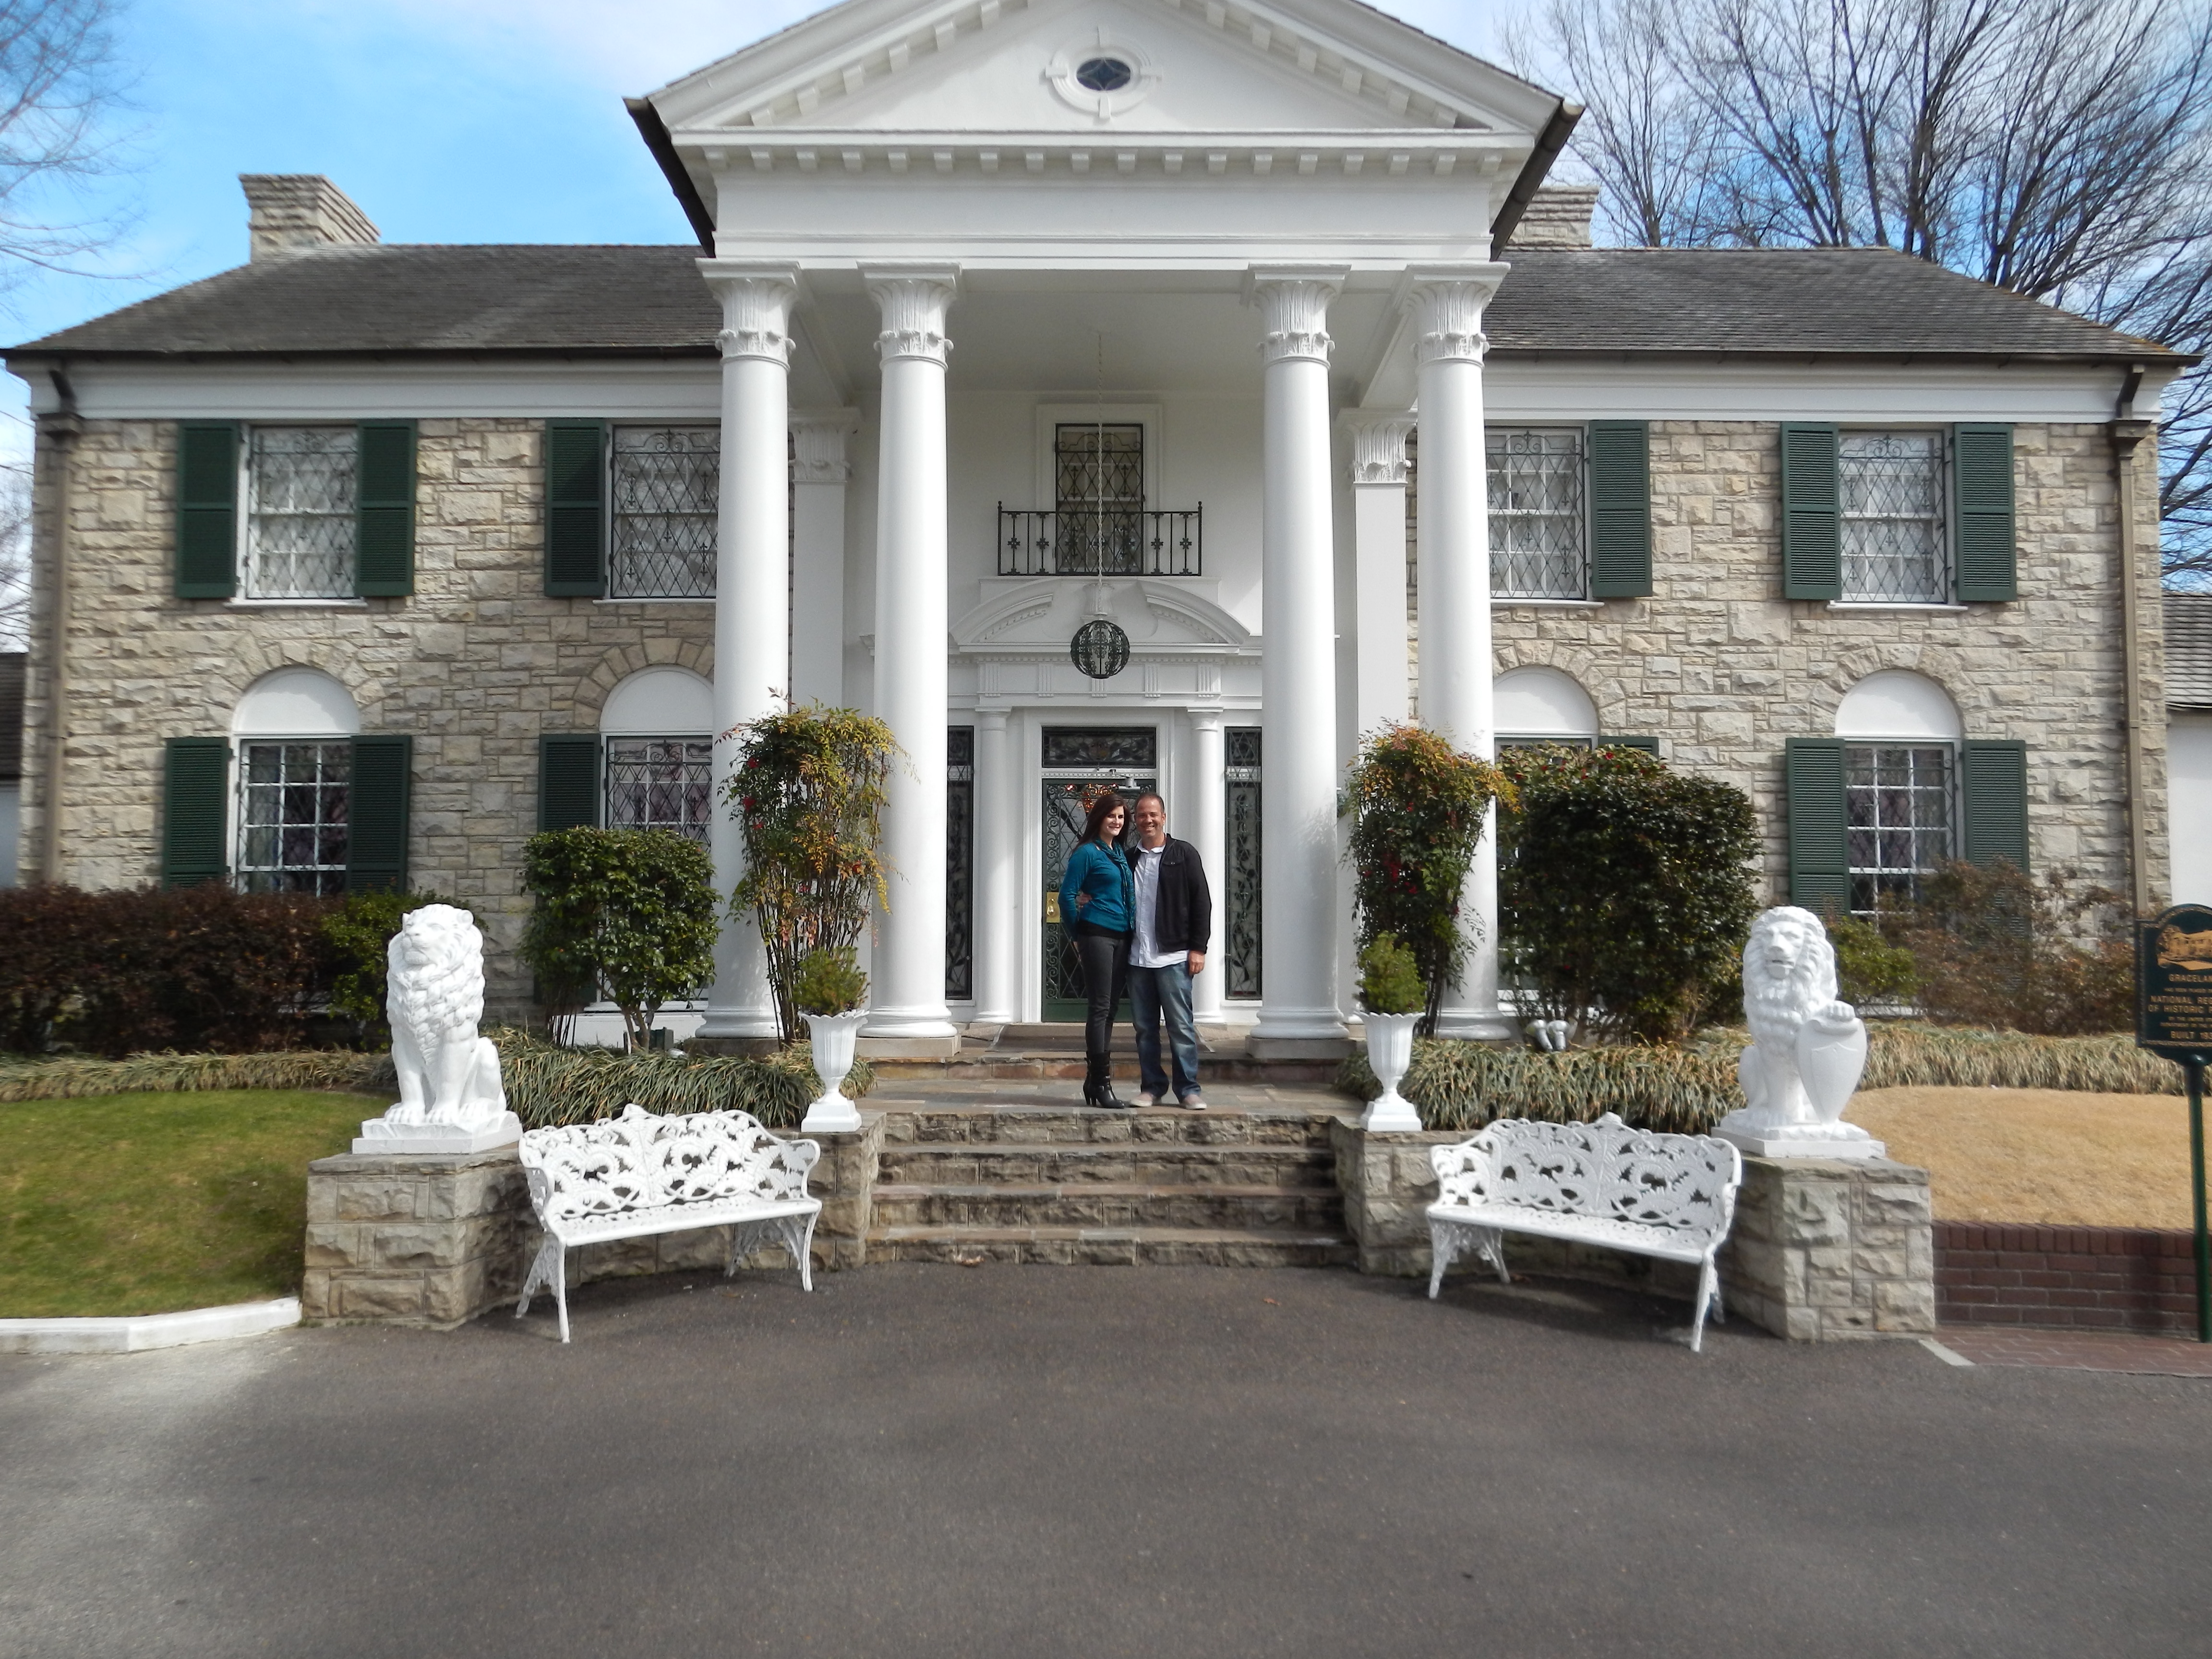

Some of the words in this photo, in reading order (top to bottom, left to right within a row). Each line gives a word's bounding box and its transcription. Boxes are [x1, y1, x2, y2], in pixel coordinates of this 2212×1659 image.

[2151, 996, 2192, 1004] NATIONAL
[2148, 1004, 2159, 1012] OF
[2164, 1005, 2204, 1013] HISTORIC
[2171, 1031, 2195, 1039] BUILT
